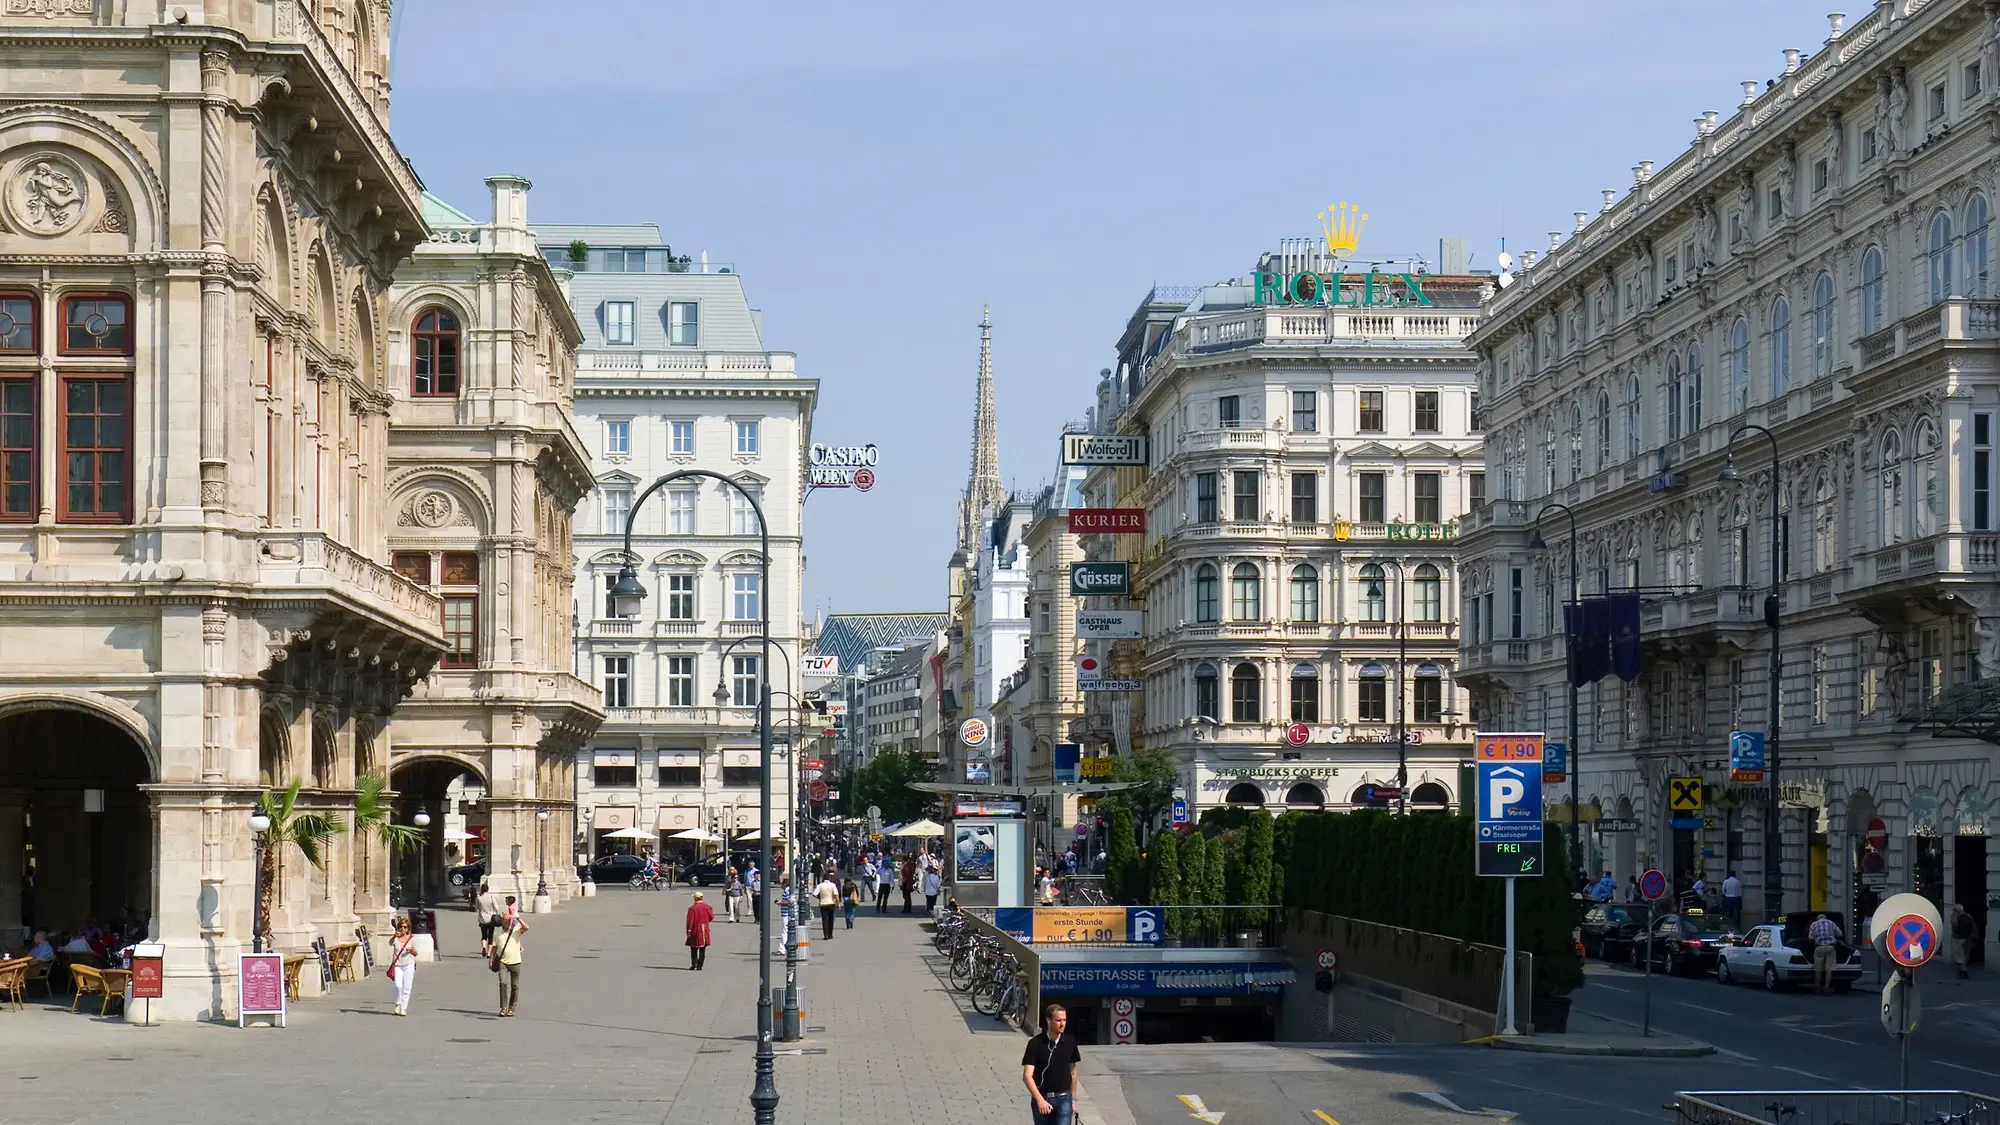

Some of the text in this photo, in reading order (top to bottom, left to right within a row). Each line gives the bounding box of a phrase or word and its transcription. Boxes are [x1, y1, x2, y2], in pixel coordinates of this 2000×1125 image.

[1250, 271, 1431, 304] ROLEX
[810, 443, 879, 466] CASINO
[1083, 443, 1127, 455] Wolford
[810, 469, 849, 484] WIEN
[1074, 515, 1140, 526] KURIER
[1074, 567, 1123, 589] Gösser
[806, 657, 833, 669] TÜV
[964, 724, 984, 733] BURGER
[965, 728, 985, 740] KING
[1314, 727, 1343, 743] LG
[1485, 743, 1535, 760] € 1,90
[1216, 768, 1339, 777] STARBUCKS COFFEE
[1490, 778, 1524, 818] P
[1599, 820, 1636, 830] AIRFIELD
[1497, 844, 1520, 853] FREI
[1075, 918, 1103, 926] Stunde
[1067, 929, 1077, 941] €
[1120, 1024, 1128, 1034] 10
